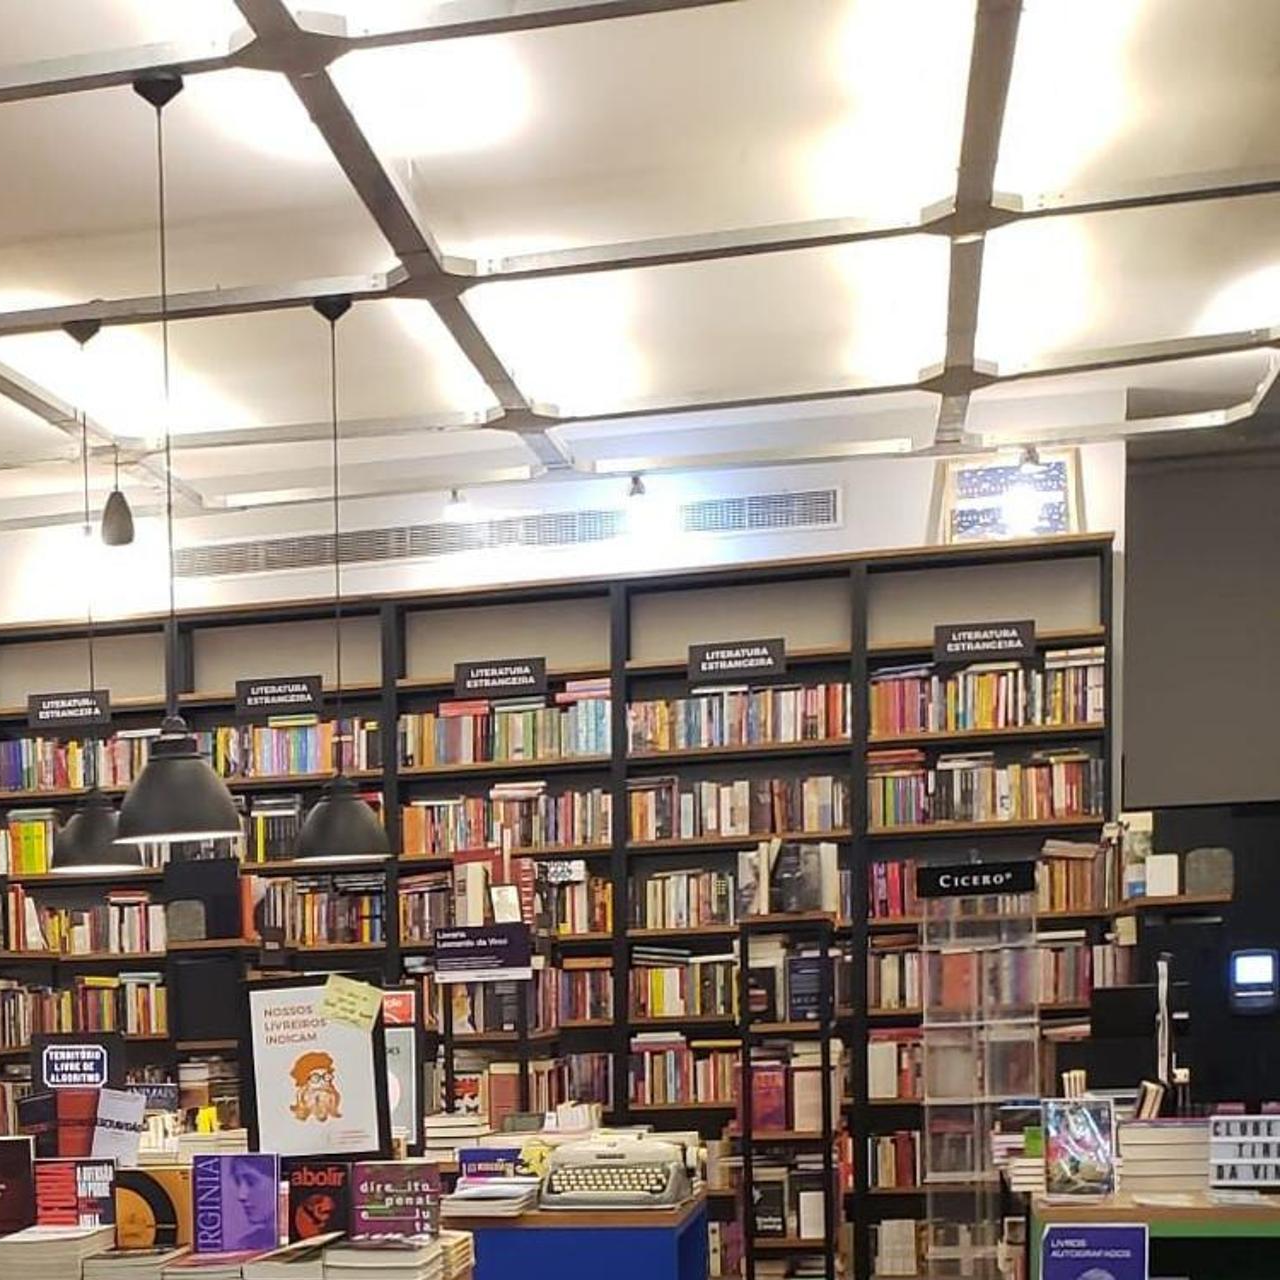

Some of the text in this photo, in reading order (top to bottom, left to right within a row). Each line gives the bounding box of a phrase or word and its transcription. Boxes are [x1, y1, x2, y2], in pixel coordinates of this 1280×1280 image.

[951, 628, 1018, 641] LITERATURA
[706, 647, 768, 660] LITERATURA
[470, 666, 531, 678] LITERATURA
[251, 684, 308, 695] LITERATURA
[42, 698, 96, 709] LITERATURA
[264, 1005, 313, 1018] NOSSOS
[264, 1018, 328, 1032] LIVREIROS
[265, 1033, 318, 1046] INDICAM
[291, 1168, 345, 1188] abolir
[198, 1157, 221, 1254] IRGINIA
